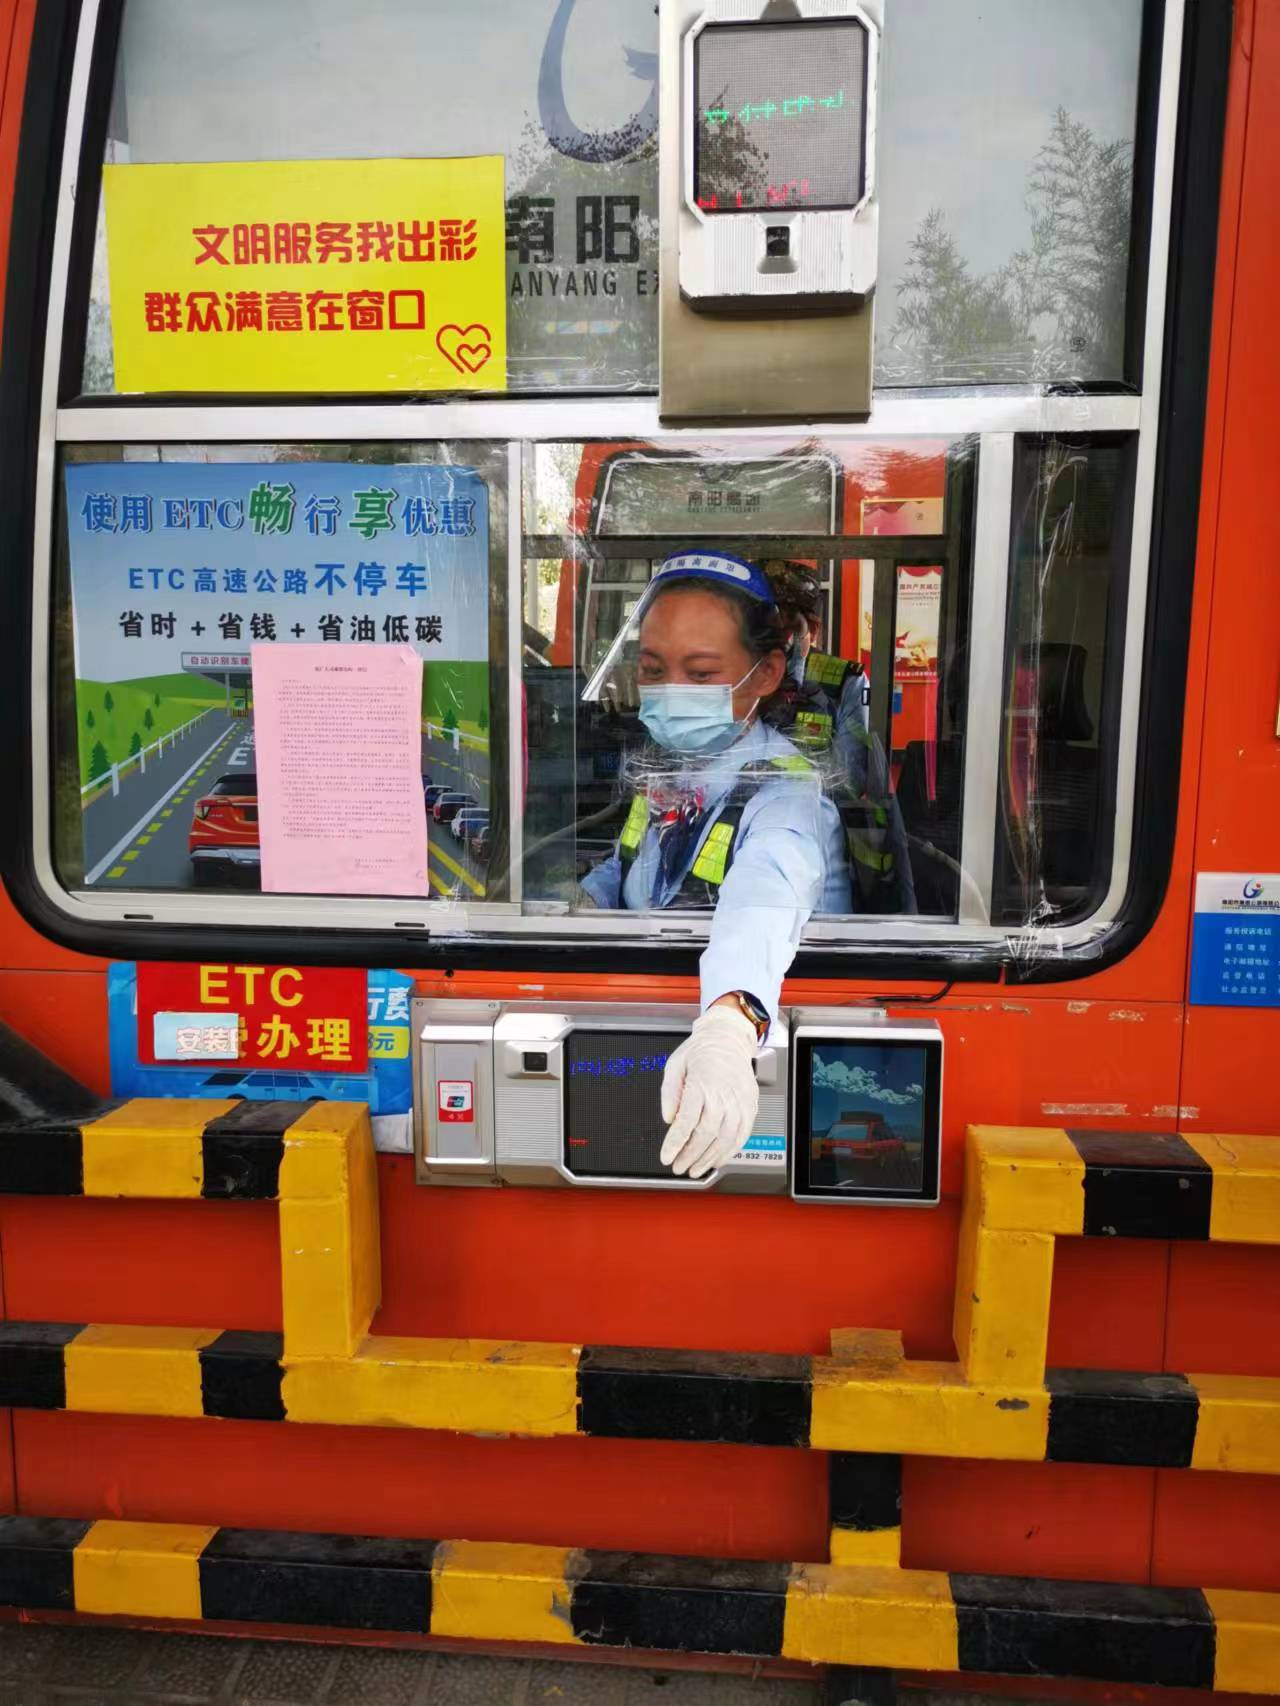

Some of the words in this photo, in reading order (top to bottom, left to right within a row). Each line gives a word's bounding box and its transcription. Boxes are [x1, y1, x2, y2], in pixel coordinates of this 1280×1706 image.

[192, 219, 478, 265] 文明服务我出彩
[144, 289, 425, 333] 群众满意在窗口
[200, 966, 304, 1006] ETC
